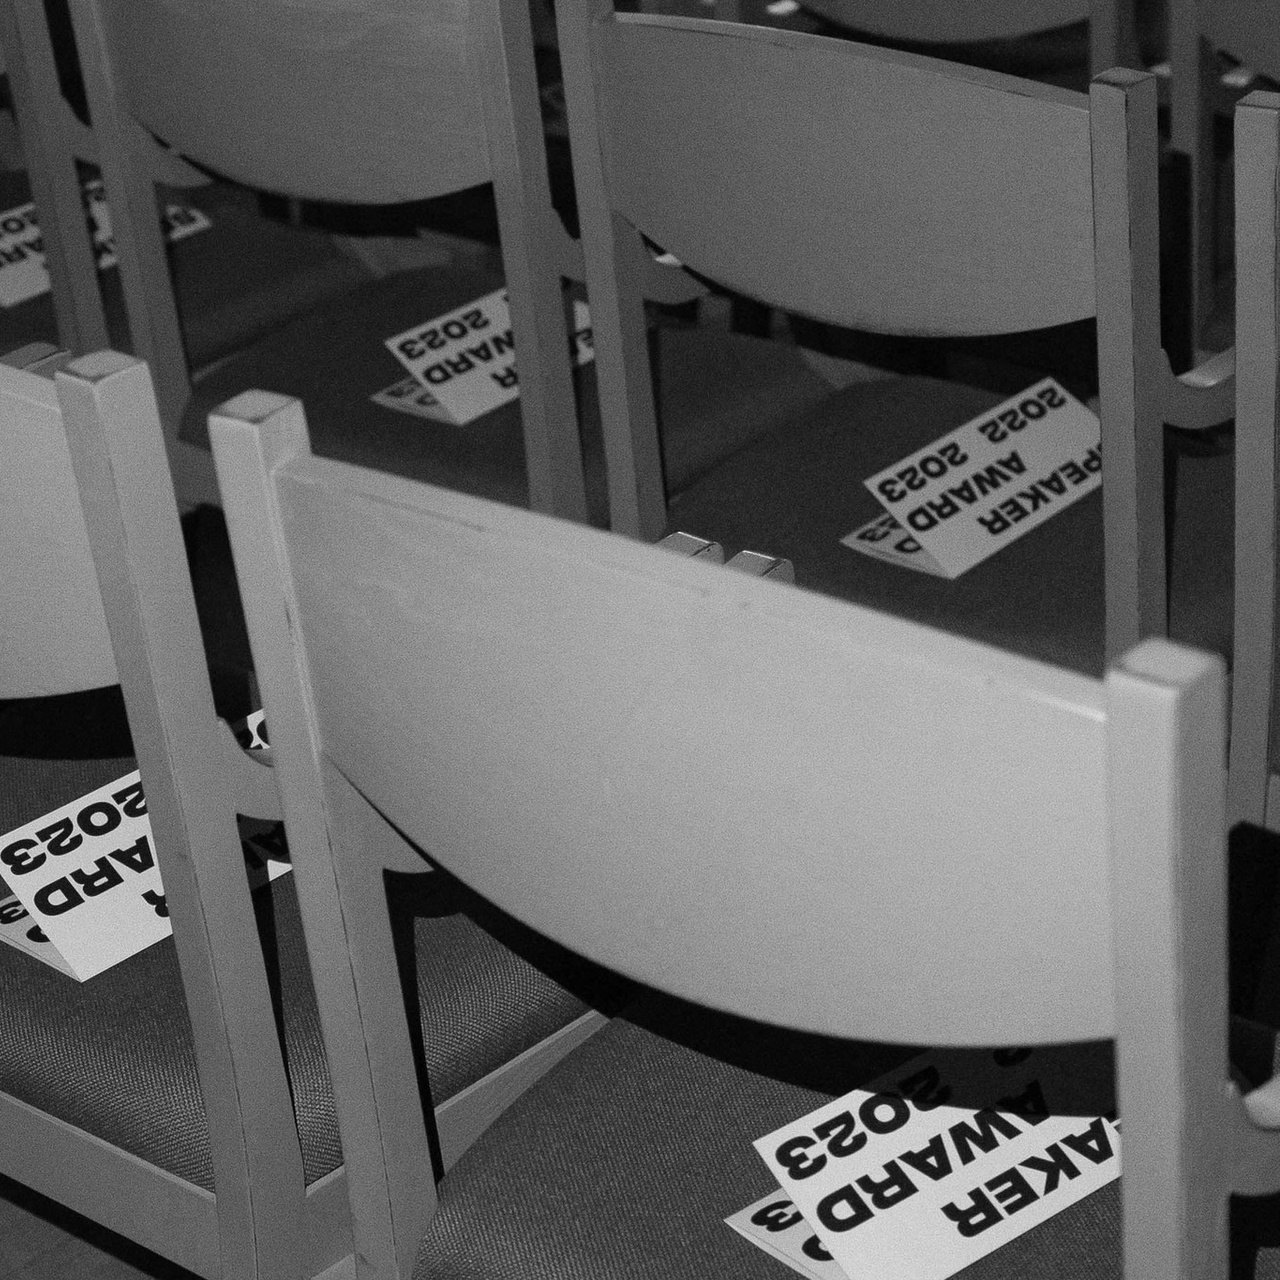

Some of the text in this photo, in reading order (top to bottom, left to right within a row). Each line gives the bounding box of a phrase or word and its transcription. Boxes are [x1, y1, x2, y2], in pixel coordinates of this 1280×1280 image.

[397, 309, 490, 362] 2023
[422, 331, 515, 386] WARD
[875, 385, 1068, 505] 2022 2023
[906, 450, 1028, 533] AWARD
[977, 442, 1102, 536] PEAKER
[32, 834, 156, 917] ARD
[774, 1064, 953, 1183] 2023
[815, 1078, 1052, 1234] AWARD
[940, 1112, 1122, 1241] AKER
